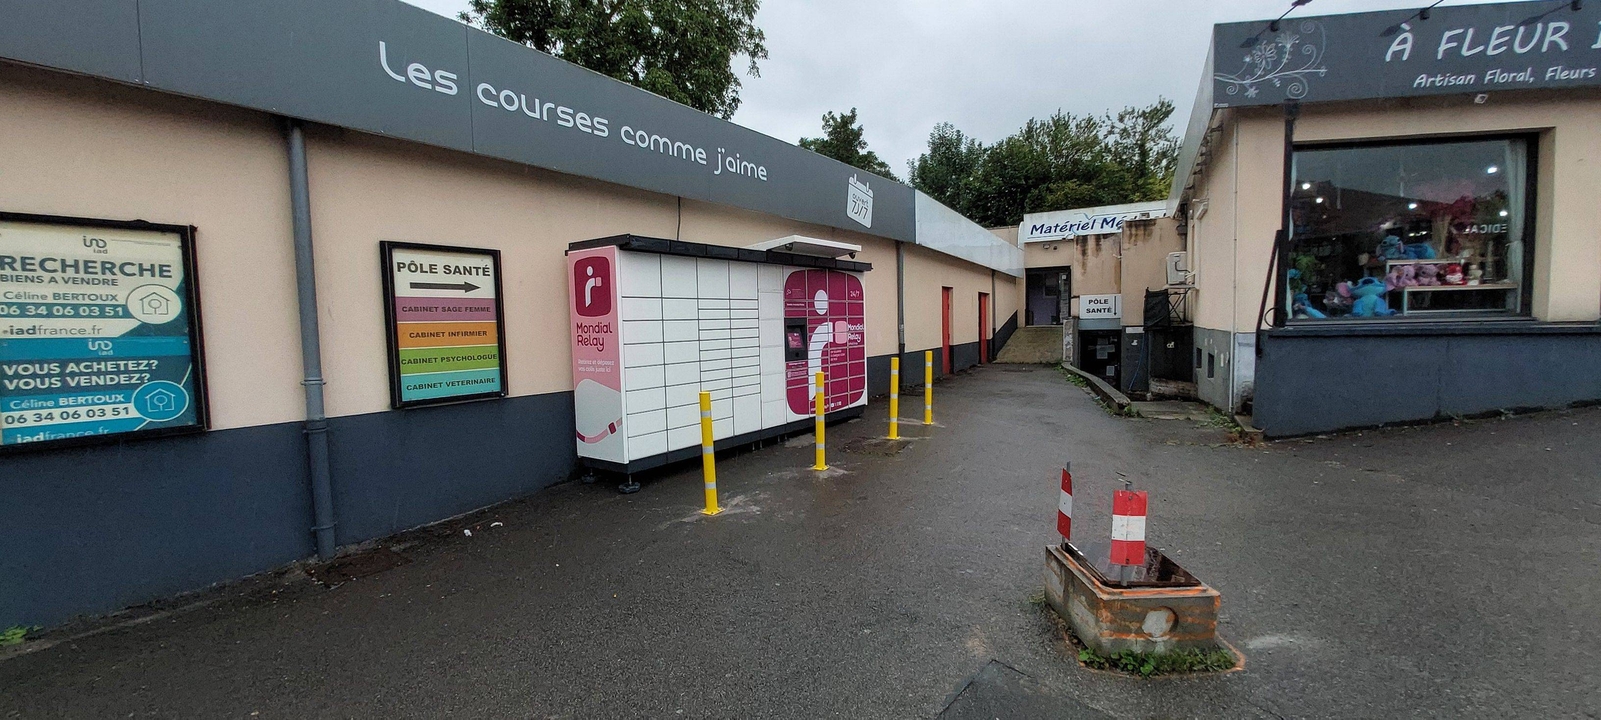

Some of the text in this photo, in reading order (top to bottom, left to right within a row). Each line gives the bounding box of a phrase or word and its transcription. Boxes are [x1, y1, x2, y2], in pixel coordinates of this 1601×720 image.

[1385, 23, 1414, 62] À
[1437, 21, 1570, 60] FLEUR
[1413, 66, 1597, 89] Artisan Floral, Fleurs
[379, 40, 768, 181] Les courses comme j'aime
[1030, 218, 1097, 236] Matériel
[0, 255, 173, 279] RECHERCHE
[397, 261, 490, 277] PÔLE SANTÉ
[0, 274, 119, 286] BIENS A VENDRE
[3, 291, 119, 302] Céline BERTOUX
[0, 305, 123, 316] 06 34 06 03 51
[576, 321, 613, 334] Mondial
[577, 334, 605, 352] Relay
[440, 354, 498, 363] PSYCHOLOGUE
[2, 360, 158, 376] VOUS ACHETEZ?
[3, 373, 151, 390] VOUS VENDEZ?
[406, 377, 496, 391] CABINET VETERINAIRE
[10, 393, 125, 410] Céline BERTOUX
[4, 406, 130, 425] 06 34 06 03 51
